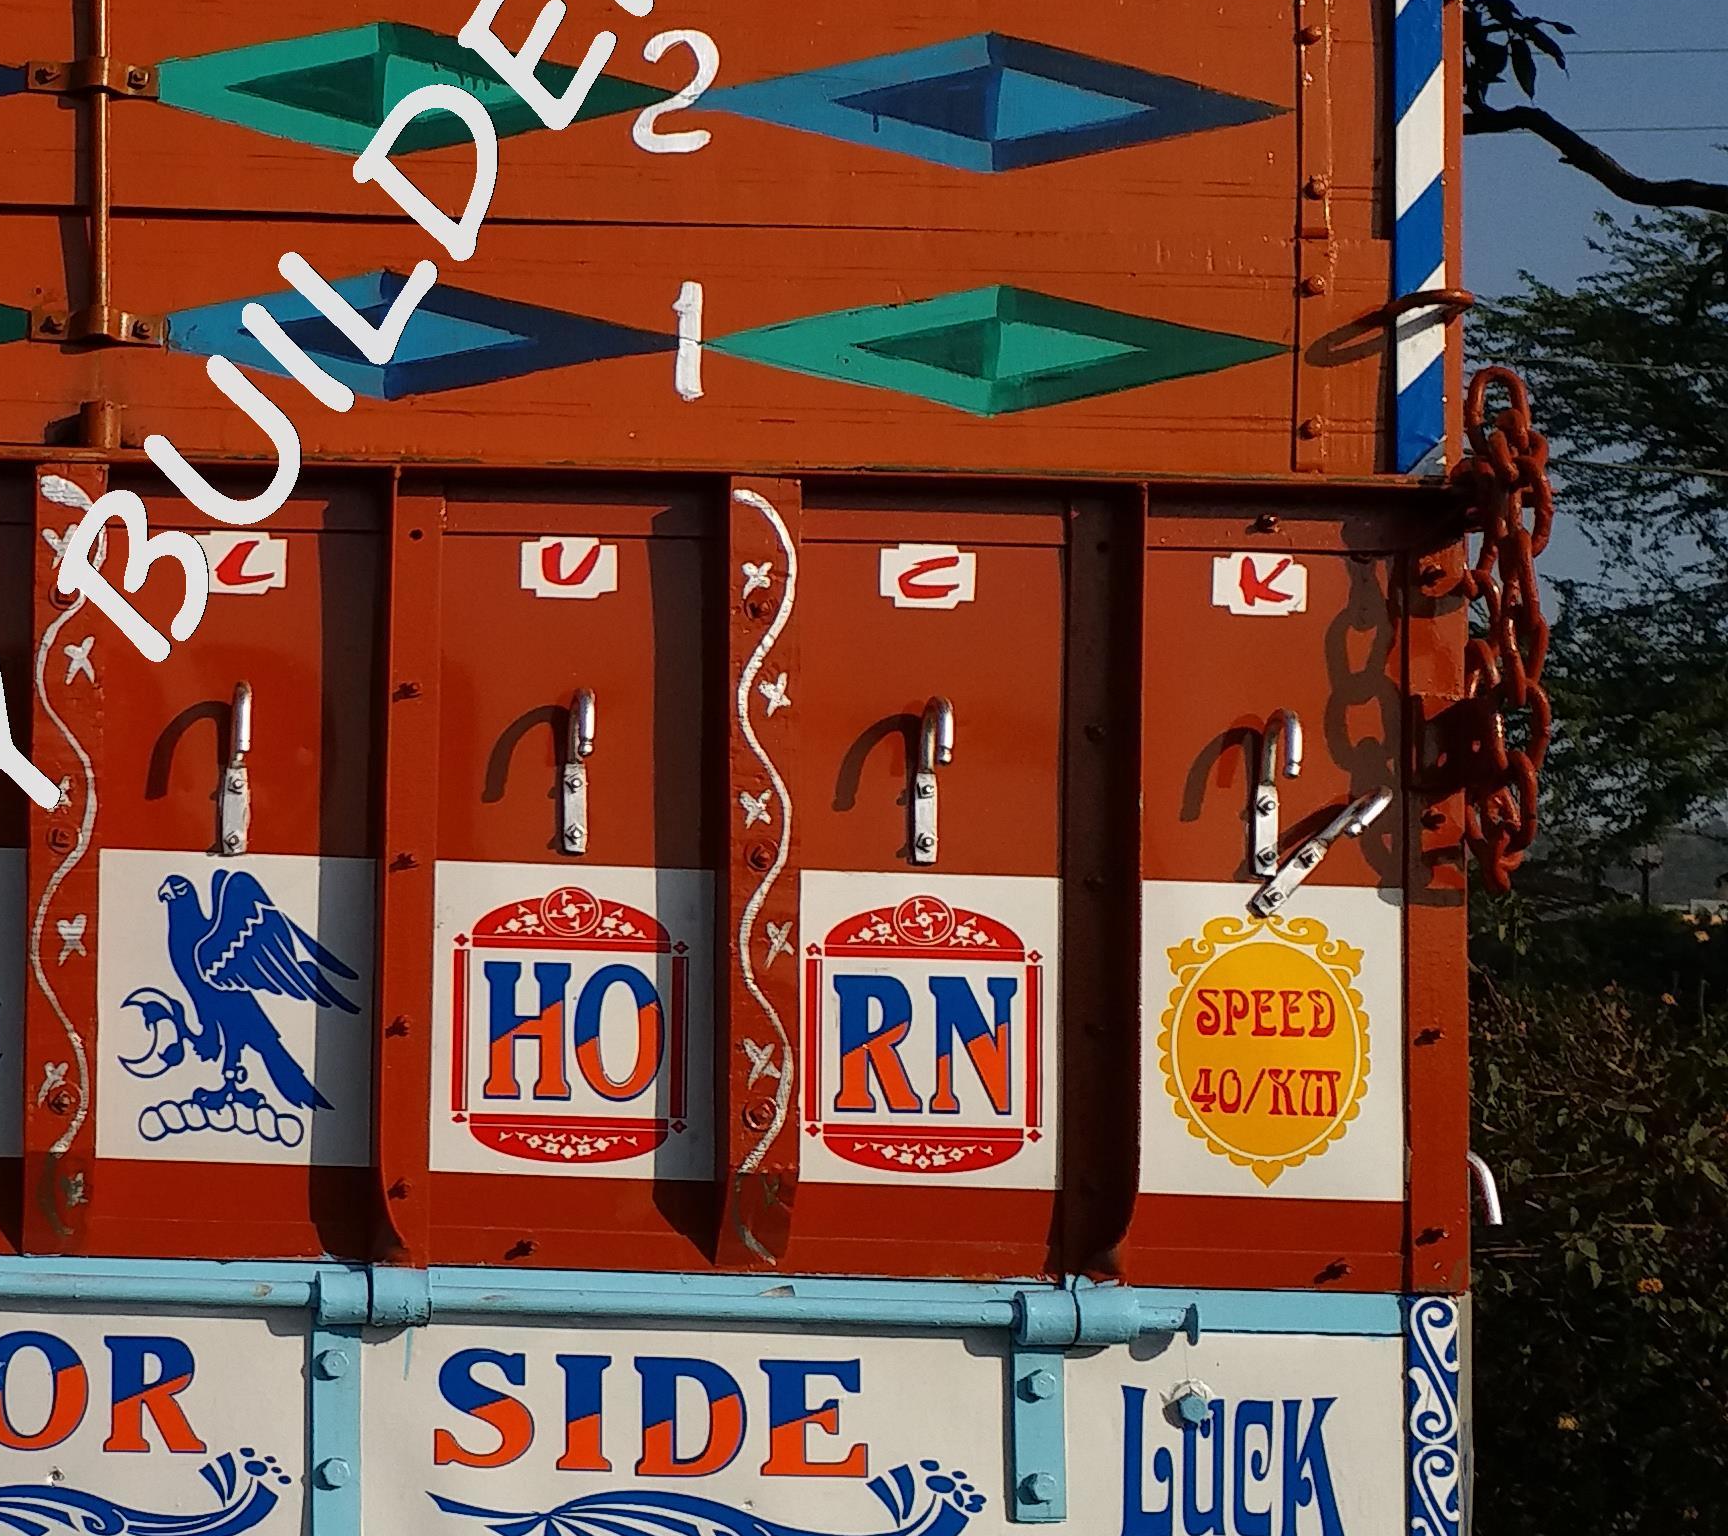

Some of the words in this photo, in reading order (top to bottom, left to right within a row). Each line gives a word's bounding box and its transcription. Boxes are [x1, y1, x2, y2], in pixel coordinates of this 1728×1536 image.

[633, 30, 719, 154] 2
[672, 281, 704, 400] 1
[1238, 558, 1294, 603] K
[481, 961, 666, 1101] HO
[832, 974, 1018, 1114] RN
[1195, 988, 1336, 1038] SPEED
[1190, 1067, 1341, 1118] 40/KM
[433, 1348, 869, 1478] SIDE
